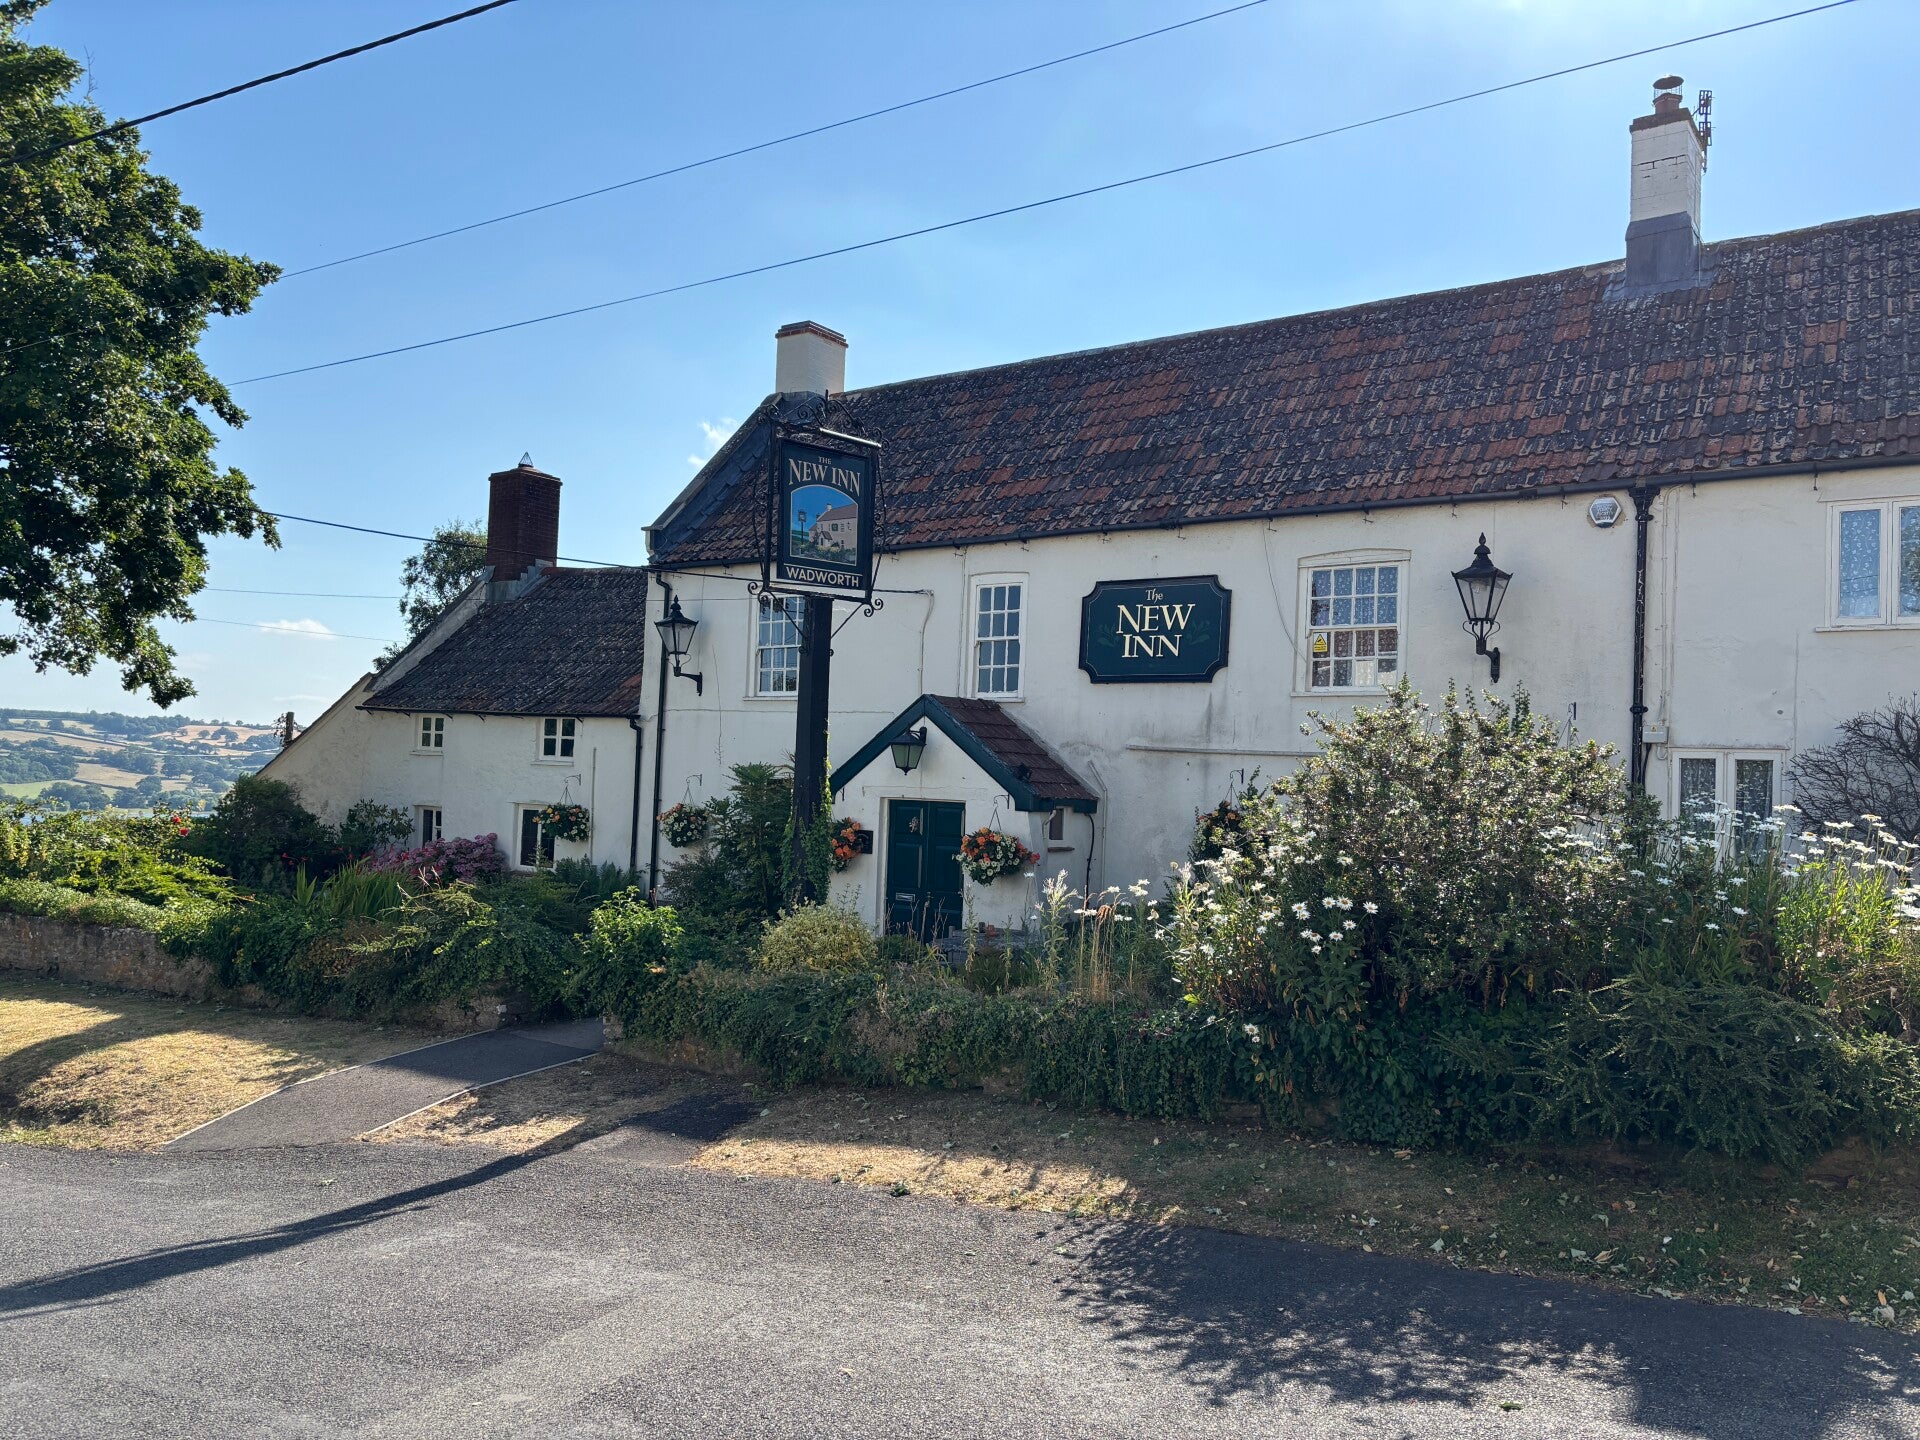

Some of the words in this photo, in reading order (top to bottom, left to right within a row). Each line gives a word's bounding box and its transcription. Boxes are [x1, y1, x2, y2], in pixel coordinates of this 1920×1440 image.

[818, 456, 832, 465] THE
[788, 458, 828, 486] NEW
[832, 467, 861, 496] INN
[786, 567, 859, 587] WADWORTH
[1145, 588, 1164, 604] The
[1116, 603, 1196, 634] NEW
[1121, 634, 1182, 658] INN
